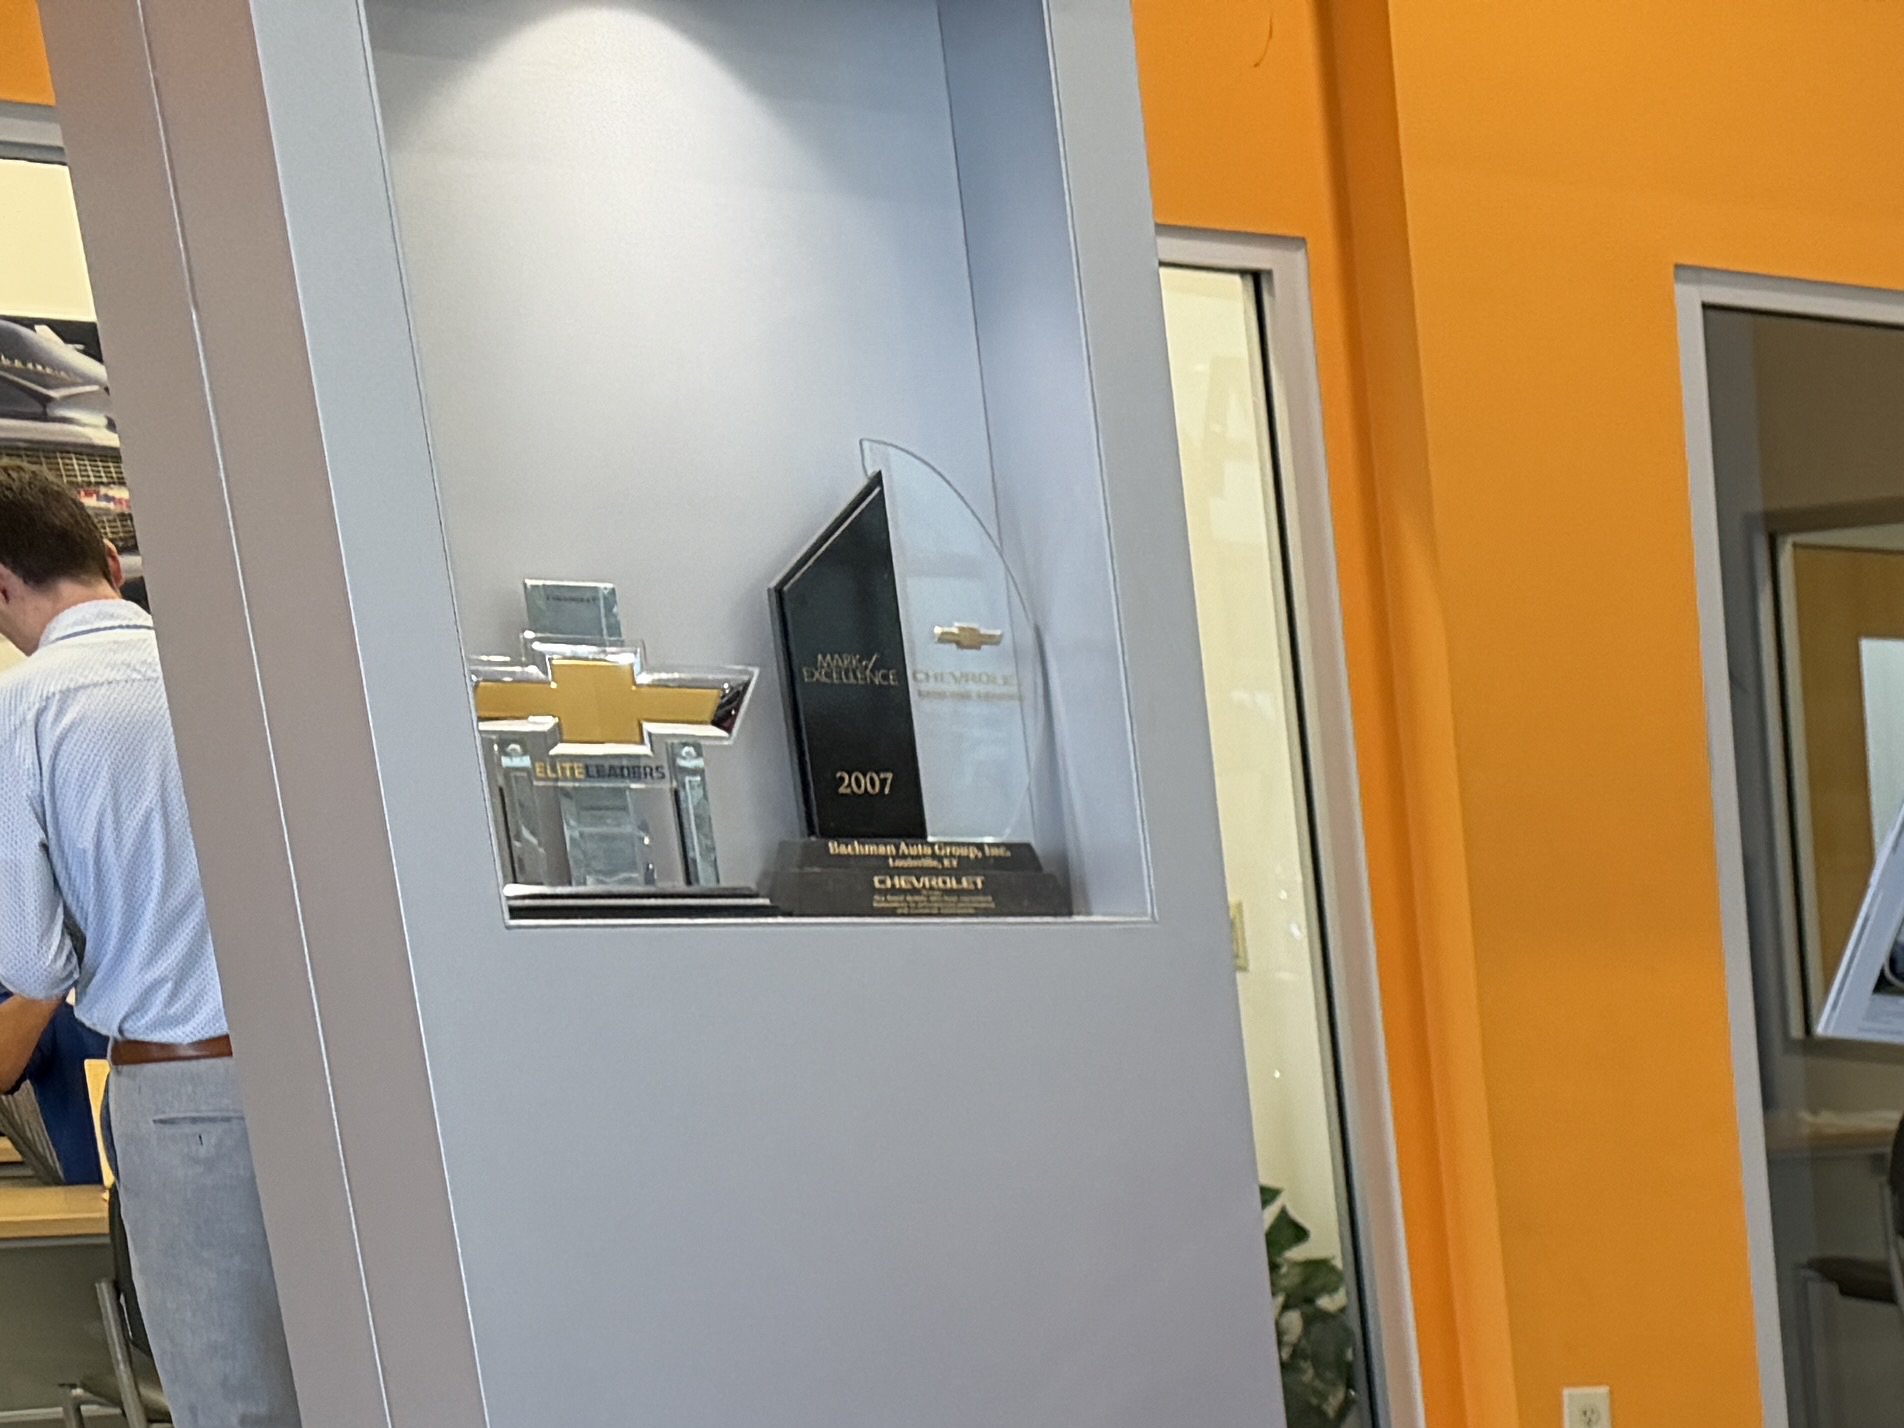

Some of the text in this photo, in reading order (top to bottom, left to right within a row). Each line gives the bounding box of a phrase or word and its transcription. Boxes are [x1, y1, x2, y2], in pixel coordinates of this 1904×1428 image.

[817, 653, 860, 670] MARK
[802, 667, 900, 686] EXCELLENCE
[836, 771, 894, 795] 2007
[828, 840, 1011, 860] Bachman Auto Group, Inc.
[873, 875, 984, 890] CHEVROLET
